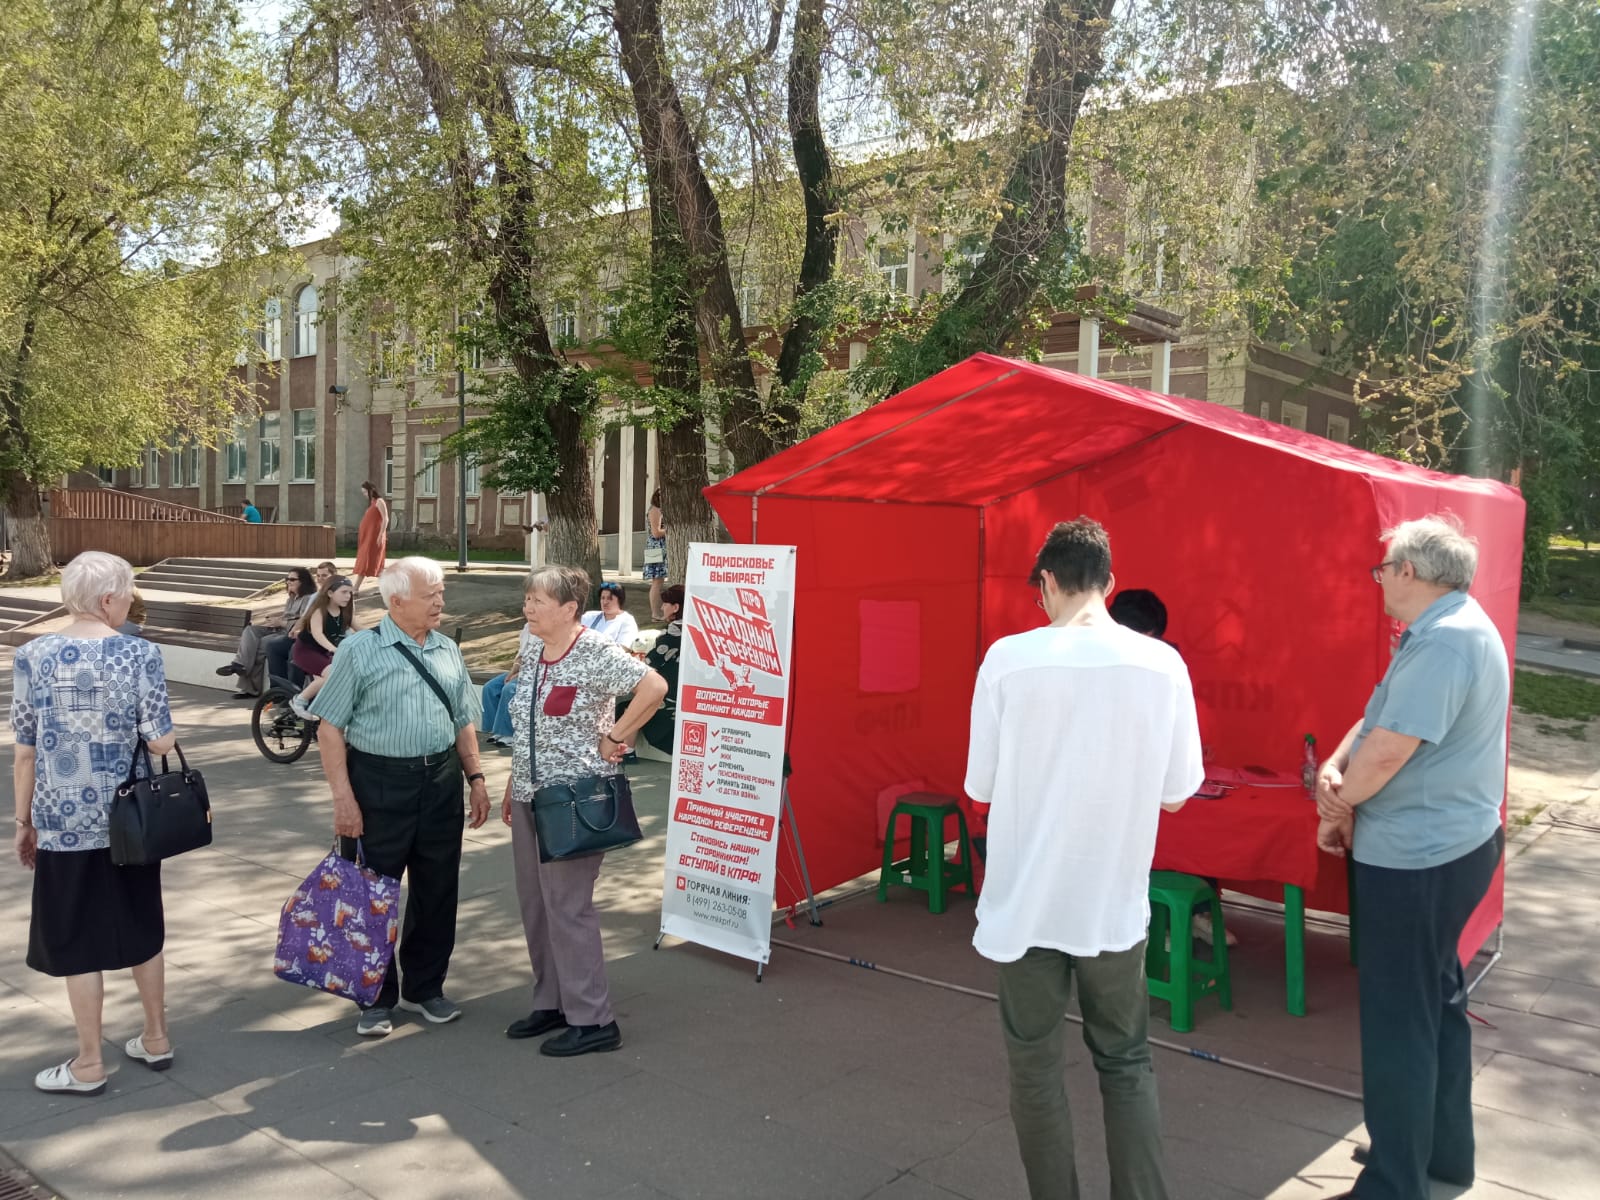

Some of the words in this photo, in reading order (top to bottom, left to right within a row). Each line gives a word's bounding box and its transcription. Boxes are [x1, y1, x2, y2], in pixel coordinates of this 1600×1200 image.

[710, 571, 765, 584] ВЫБИРАЕТ!
[697, 602, 775, 654] НАРОДНЫЙ
[710, 633, 780, 673] РЕФЕРЕНДУМ
[730, 842, 760, 856] НАШИМ
[679, 854, 720, 874] ВСТУПАЙ
[720, 864, 726, 876] В
[728, 866, 762, 884] КПРФ!
[687, 880, 720, 896] ГОРЯЧАЯ
[722, 889, 751, 905] ЛИНИЯ:
[686, 894, 690, 903] 8
[692, 896, 710, 910] (499)
[712, 900, 747, 920] 263-05-08
